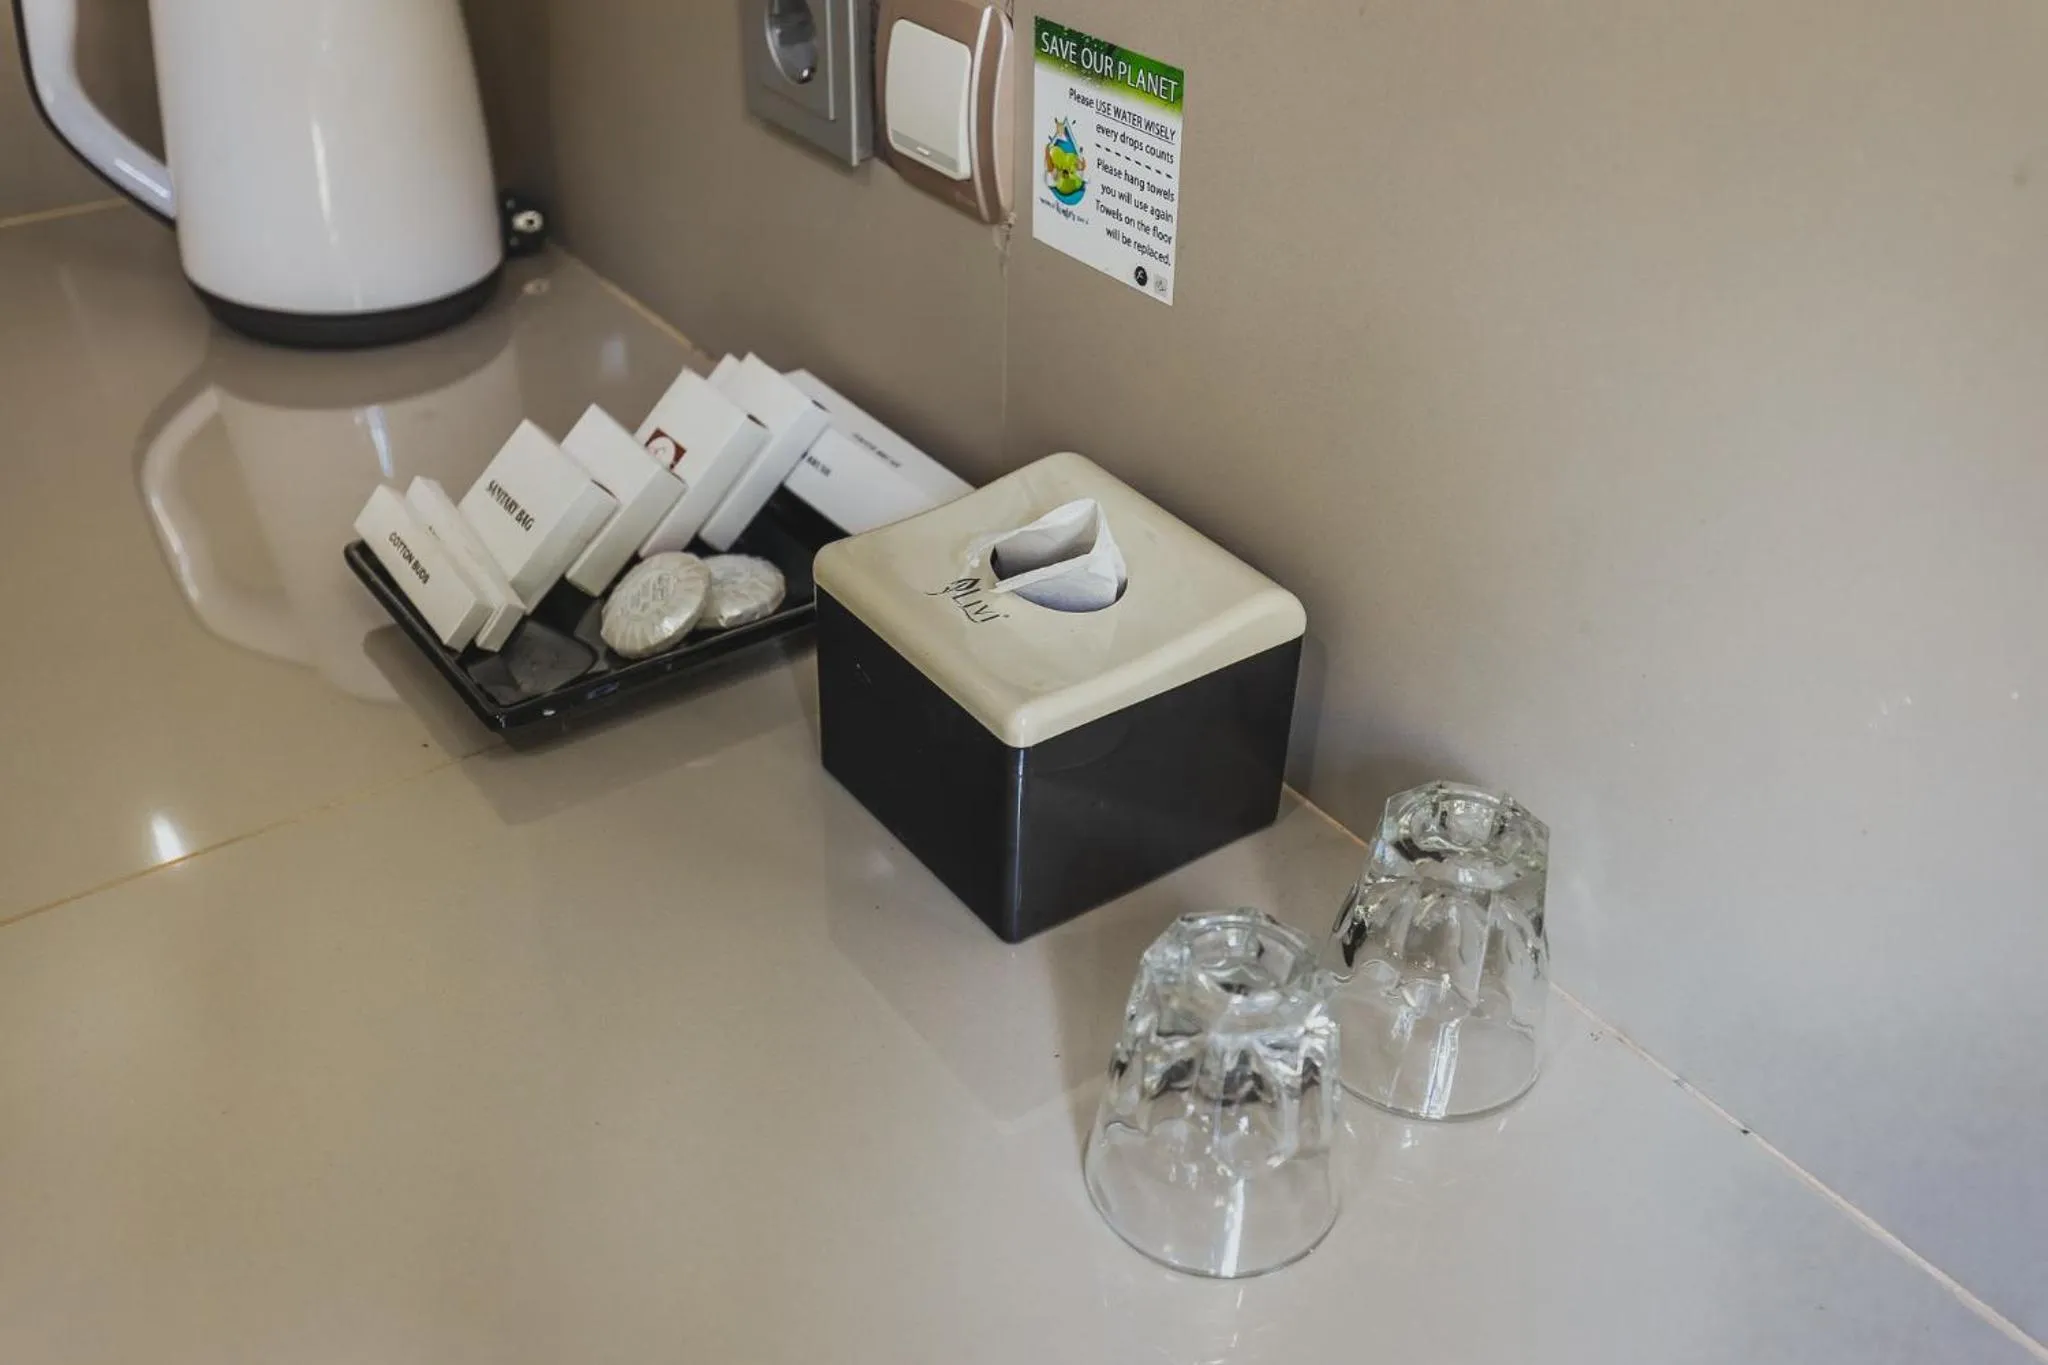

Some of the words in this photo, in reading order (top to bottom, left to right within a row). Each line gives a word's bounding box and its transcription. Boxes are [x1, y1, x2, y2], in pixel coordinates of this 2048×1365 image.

[1041, 31, 1078, 64] SAVE
[1081, 47, 1114, 79] OUR
[1117, 61, 1178, 102] PLANET
[1068, 87, 1095, 109] Please
[1096, 99, 1112, 116] USE
[1113, 105, 1143, 130] WATER
[1144, 120, 1177, 142] WISELY
[1096, 123, 1119, 143] every
[1120, 131, 1144, 152] drops
[1145, 143, 1174, 165] counts
[1097, 158, 1123, 179] Please
[1124, 168, 1145, 191] hang
[1146, 181, 1175, 202] towels
[1096, 199, 1123, 222] Towels
[1124, 214, 1136, 227] on
[1137, 220, 1151, 235] the
[1152, 226, 1173, 245] floor
[1101, 184, 1117, 199] you
[1118, 190, 1133, 205] will
[1134, 199, 1149, 213] use
[1150, 206, 1174, 224] again
[1106, 227, 1121, 241] will
[1122, 231, 1132, 246] be
[1133, 240, 1171, 266] replaced.
[485, 479, 519, 517] SANITARY
[514, 507, 535, 532] BAG
[388, 531, 416, 564] COTTON
